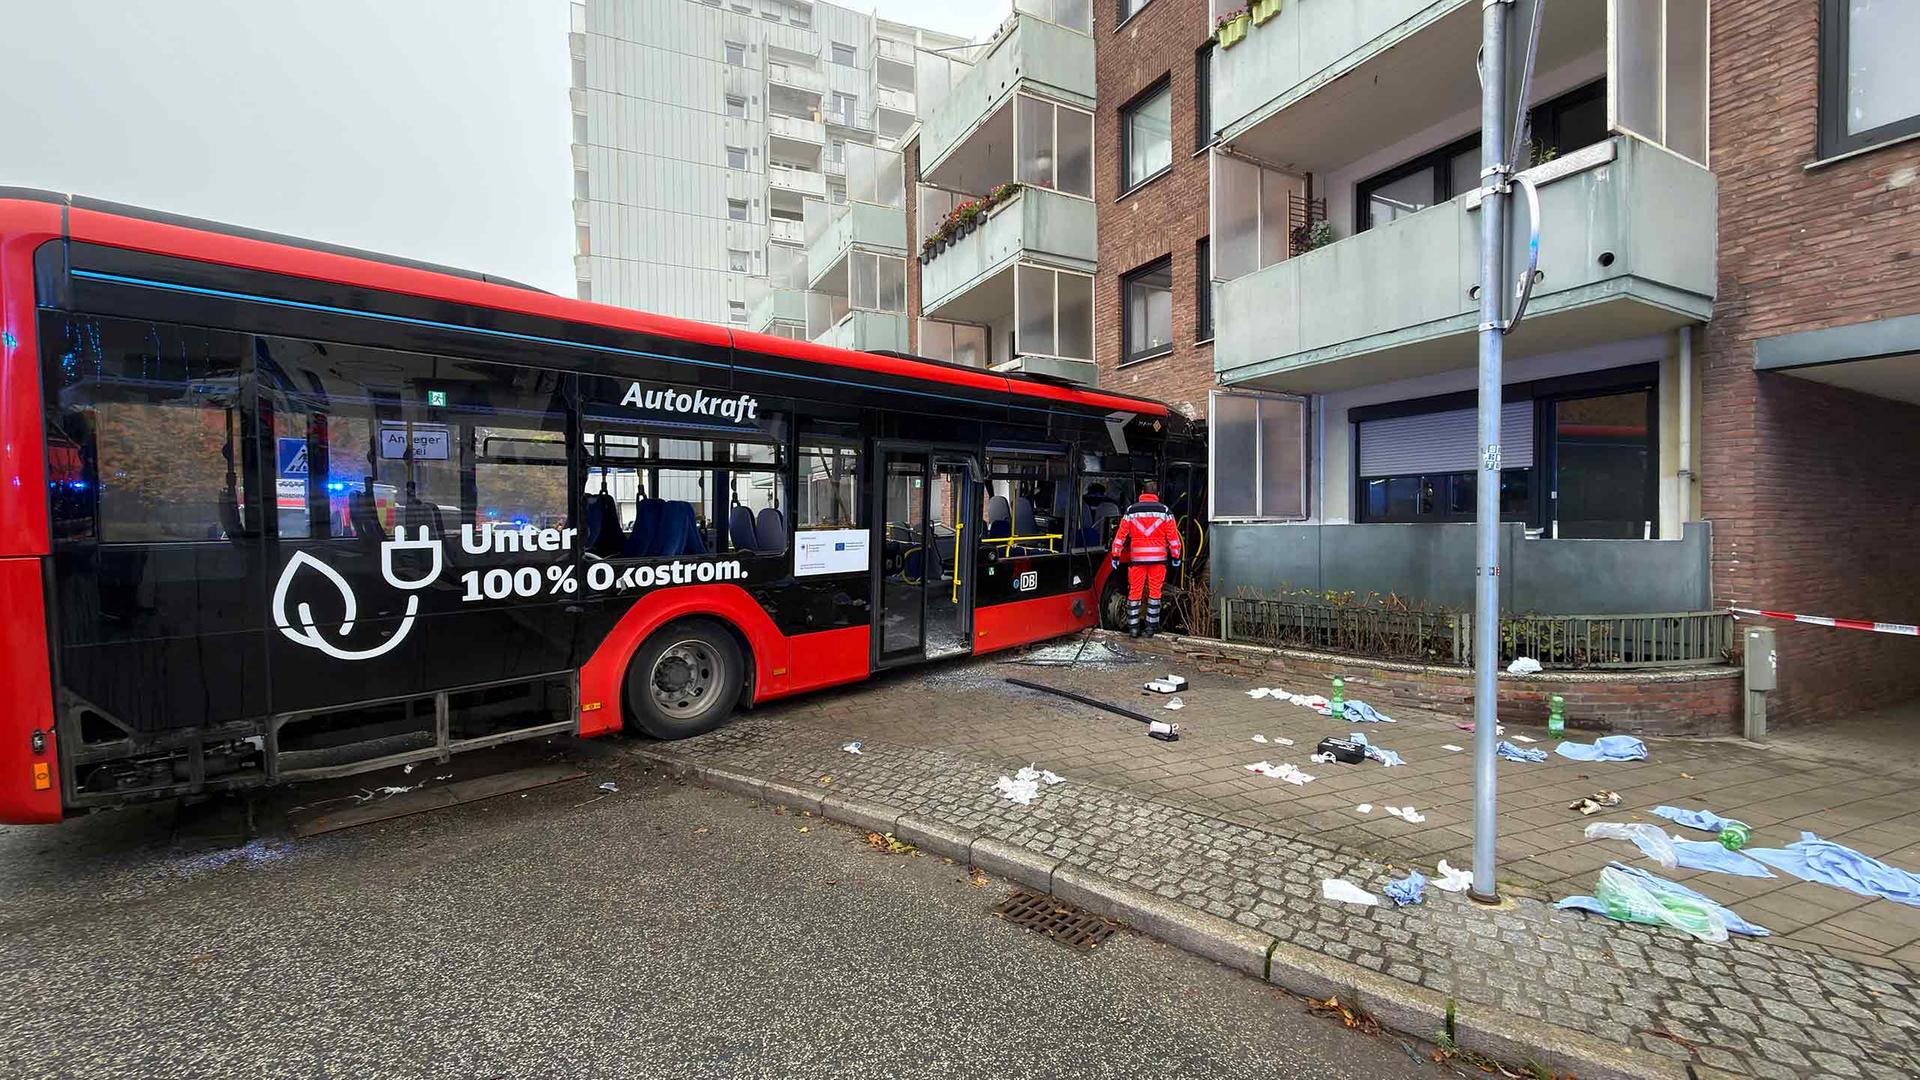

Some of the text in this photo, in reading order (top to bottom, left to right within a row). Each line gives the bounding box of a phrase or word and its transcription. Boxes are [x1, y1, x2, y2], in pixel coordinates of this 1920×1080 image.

[620, 381, 758, 422] Autokraft
[388, 434, 441, 446] Aneger
[461, 523, 577, 554] Unter
[1021, 573, 1036, 589] DB
